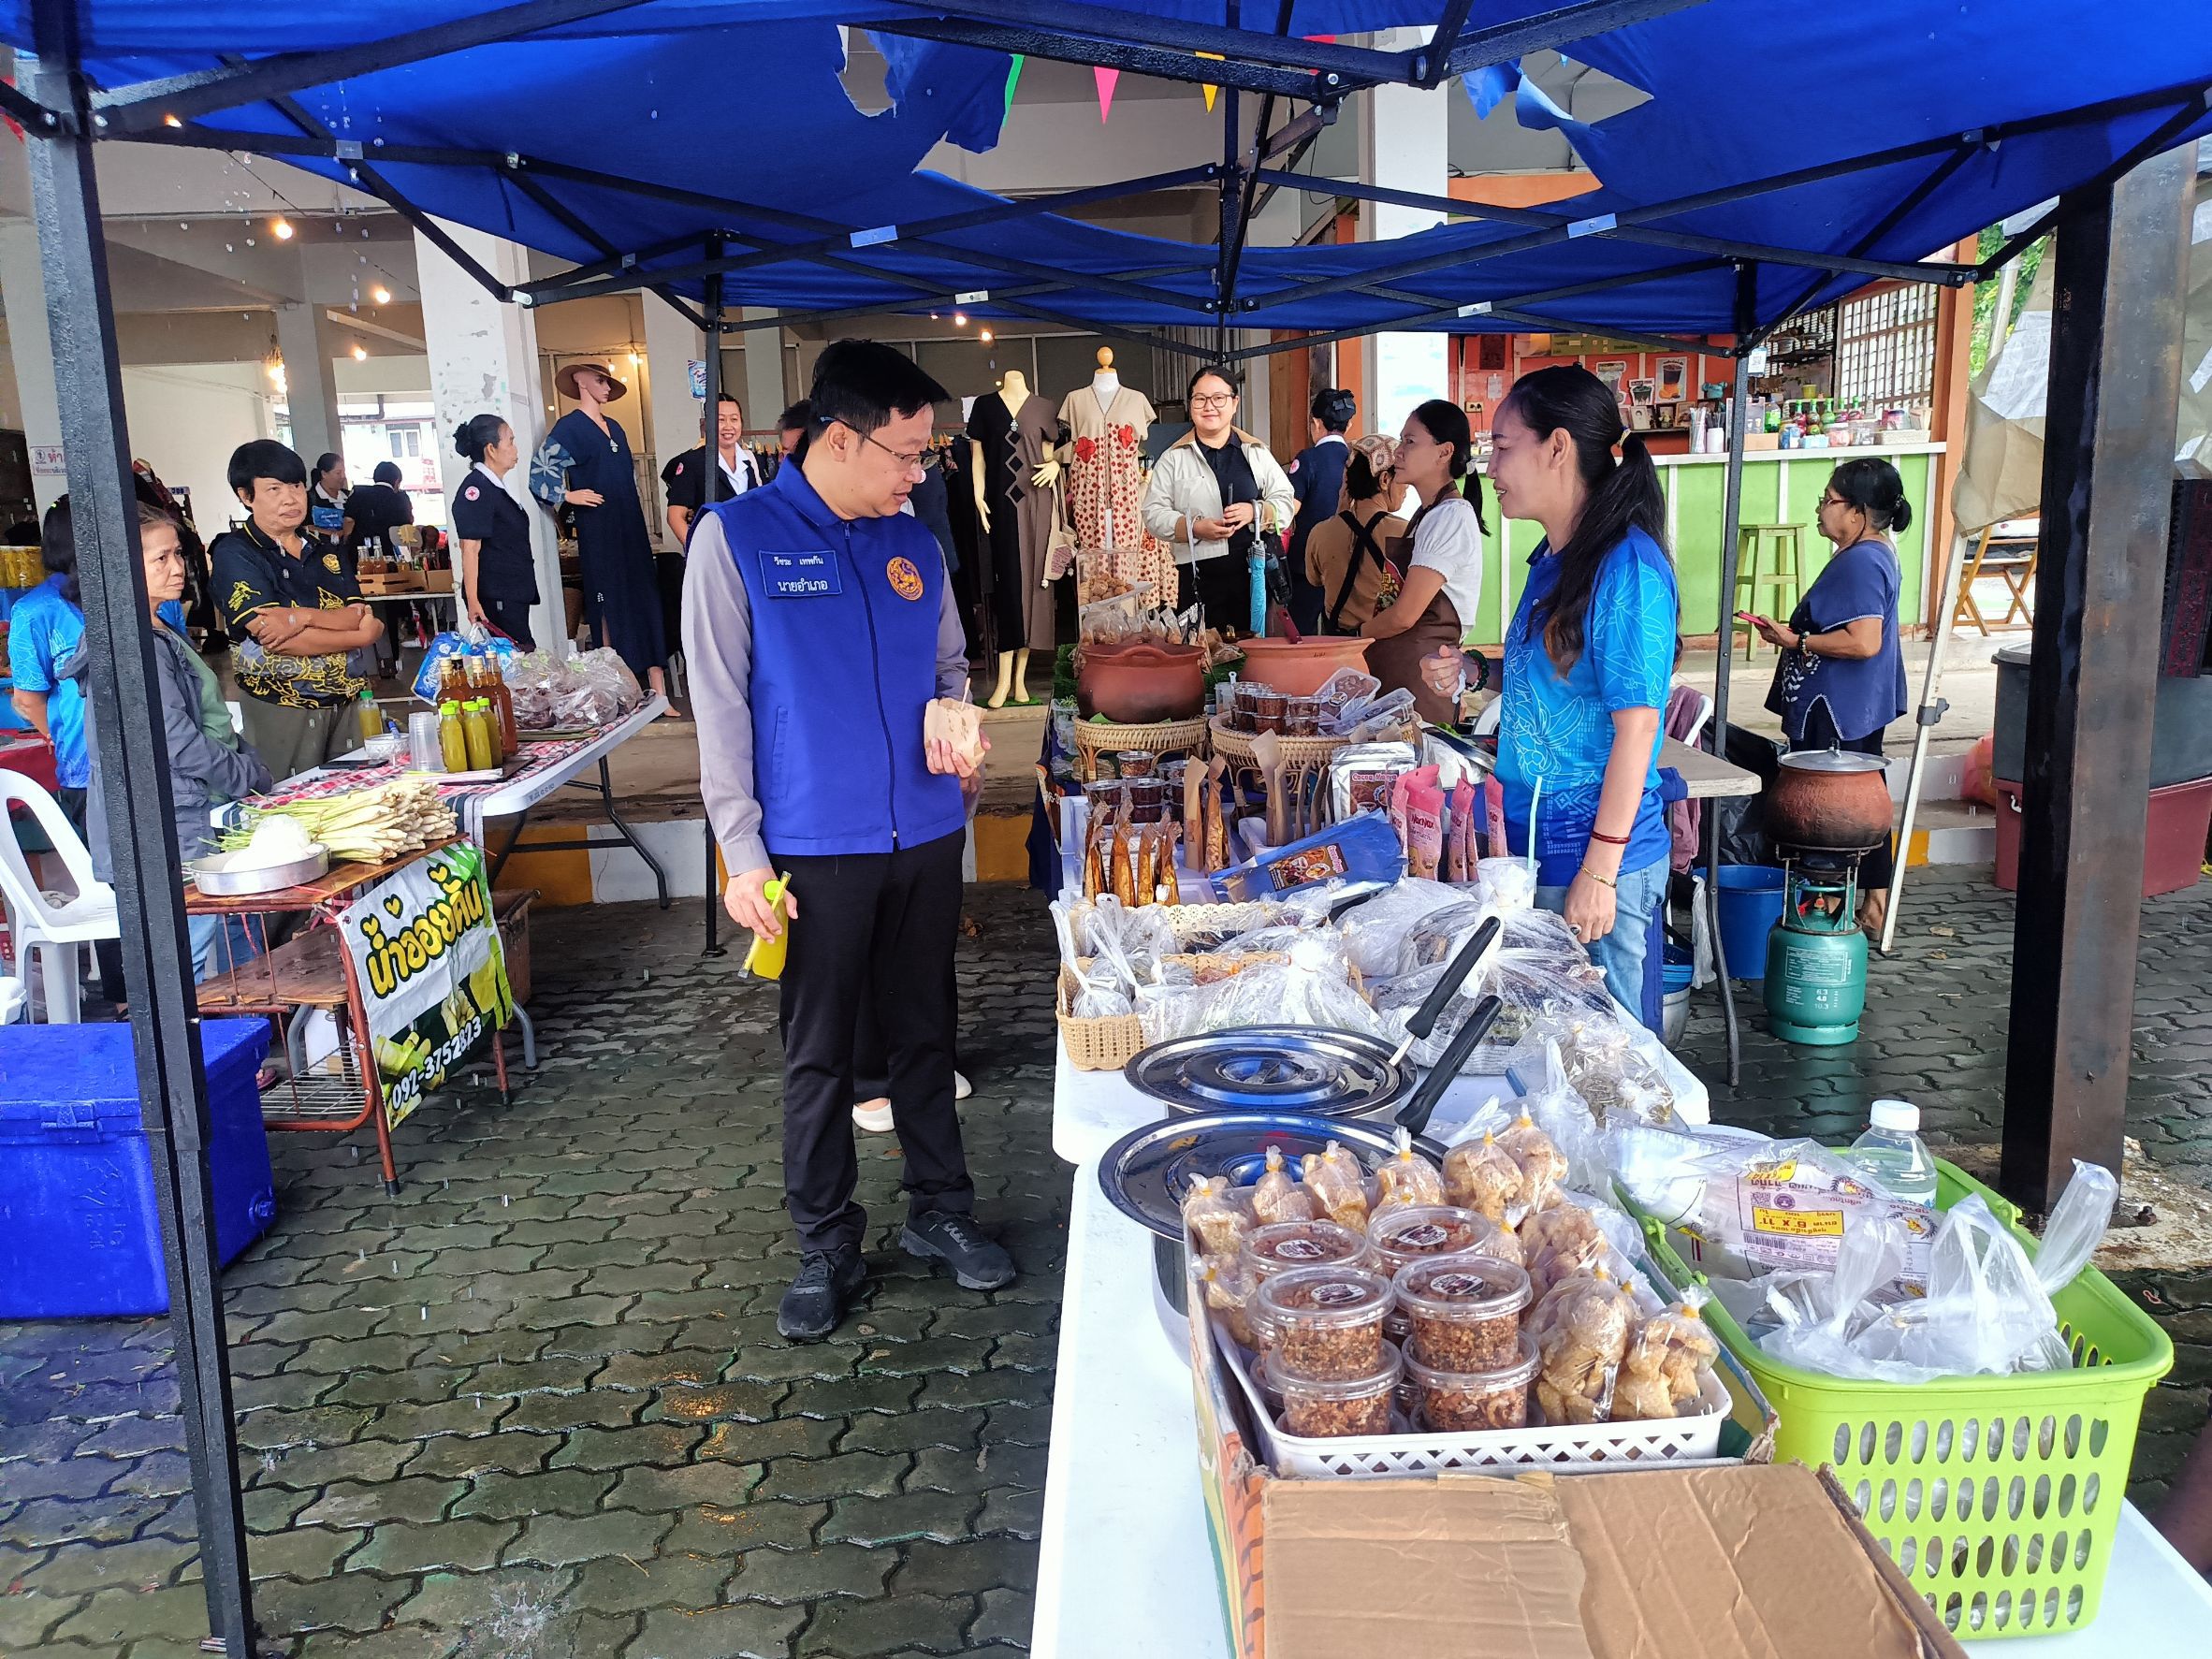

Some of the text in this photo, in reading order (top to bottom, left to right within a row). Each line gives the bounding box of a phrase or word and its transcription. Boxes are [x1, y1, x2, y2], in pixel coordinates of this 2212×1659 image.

[778, 577, 828, 592] นายอำเภอ
[360, 863, 485, 998] น้ำอ้อยคั้น
[391, 1015, 483, 1112] 092-3752823
